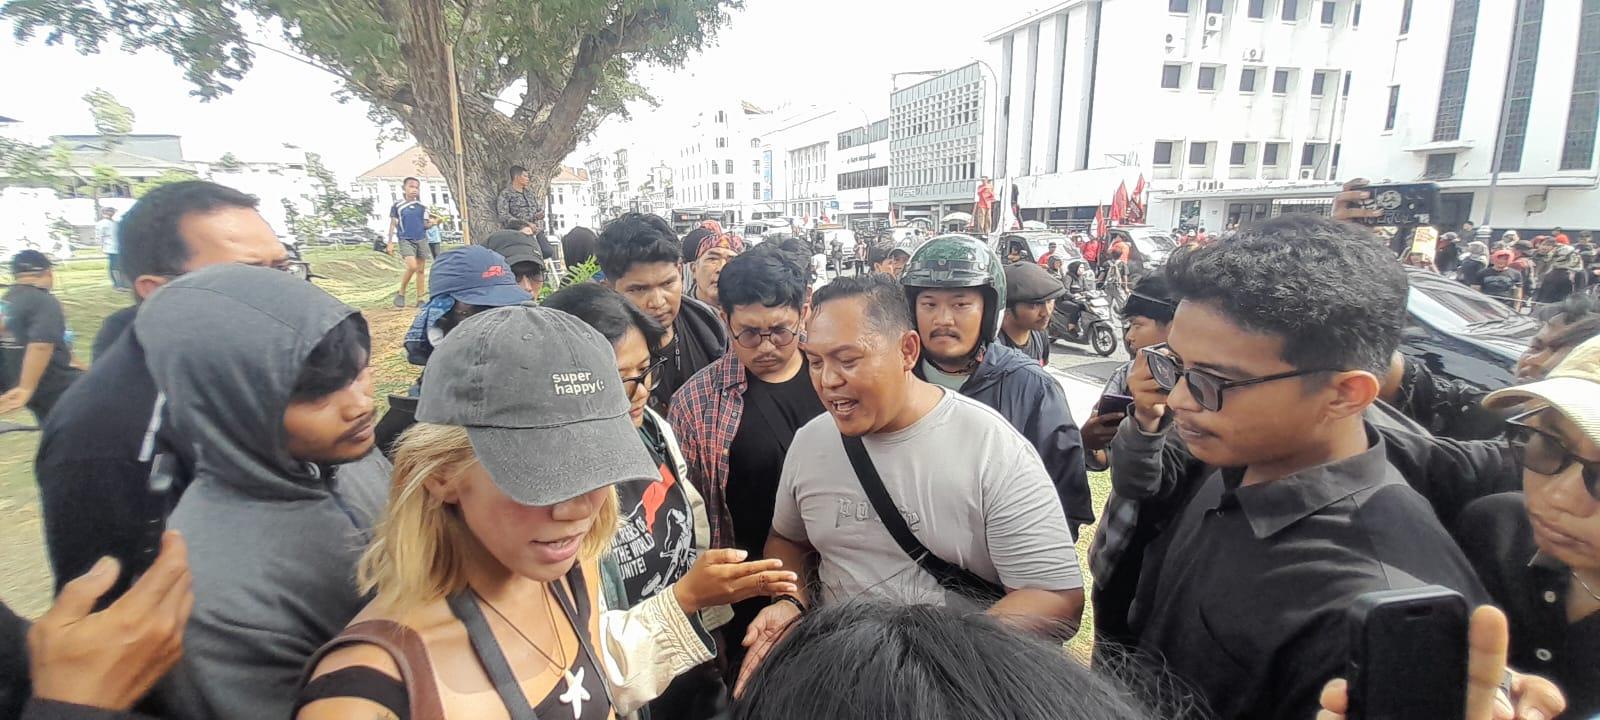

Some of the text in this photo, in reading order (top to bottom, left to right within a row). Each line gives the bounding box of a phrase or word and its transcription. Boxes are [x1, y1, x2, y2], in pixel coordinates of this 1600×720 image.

[552, 372, 591, 384] super
[613, 534, 655, 564] THE WORLD
